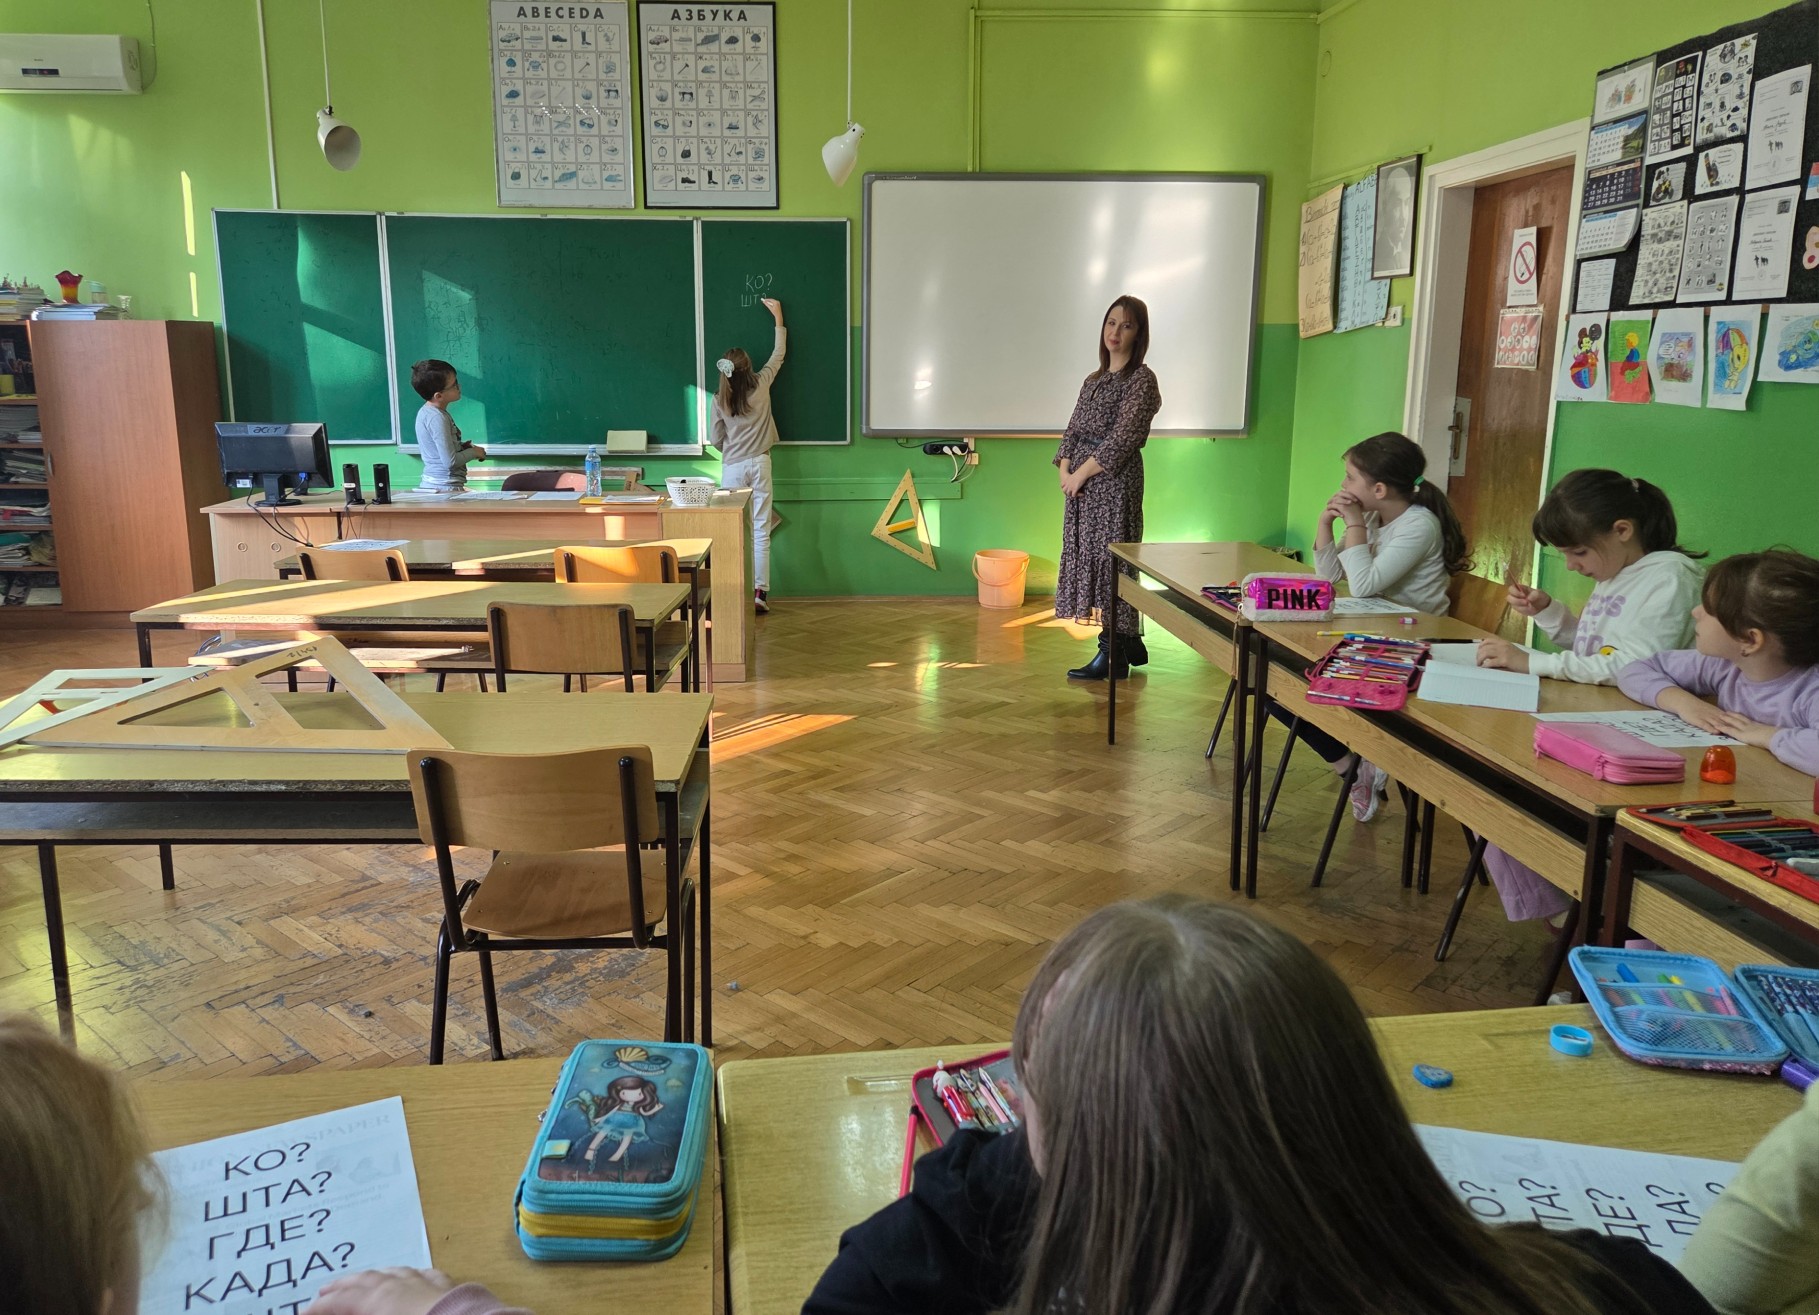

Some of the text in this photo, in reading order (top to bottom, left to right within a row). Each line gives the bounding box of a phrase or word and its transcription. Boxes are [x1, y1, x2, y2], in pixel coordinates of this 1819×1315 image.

[516, 6, 604, 20] ABECEDA
[670, 8, 748, 22] АЗБУКА
[746, 272, 772, 292] КО?
[1267, 588, 1324, 610] PINK
[224, 1142, 312, 1181] КО?
[204, 1170, 333, 1222] ШТА?
[1458, 1180, 1506, 1217] О?
[1518, 1177, 1574, 1225] ТА?
[208, 1208, 332, 1260] ГДЕ?
[1586, 1187, 1663, 1247] ДЕ?
[184, 1242, 356, 1310] КАДА?
